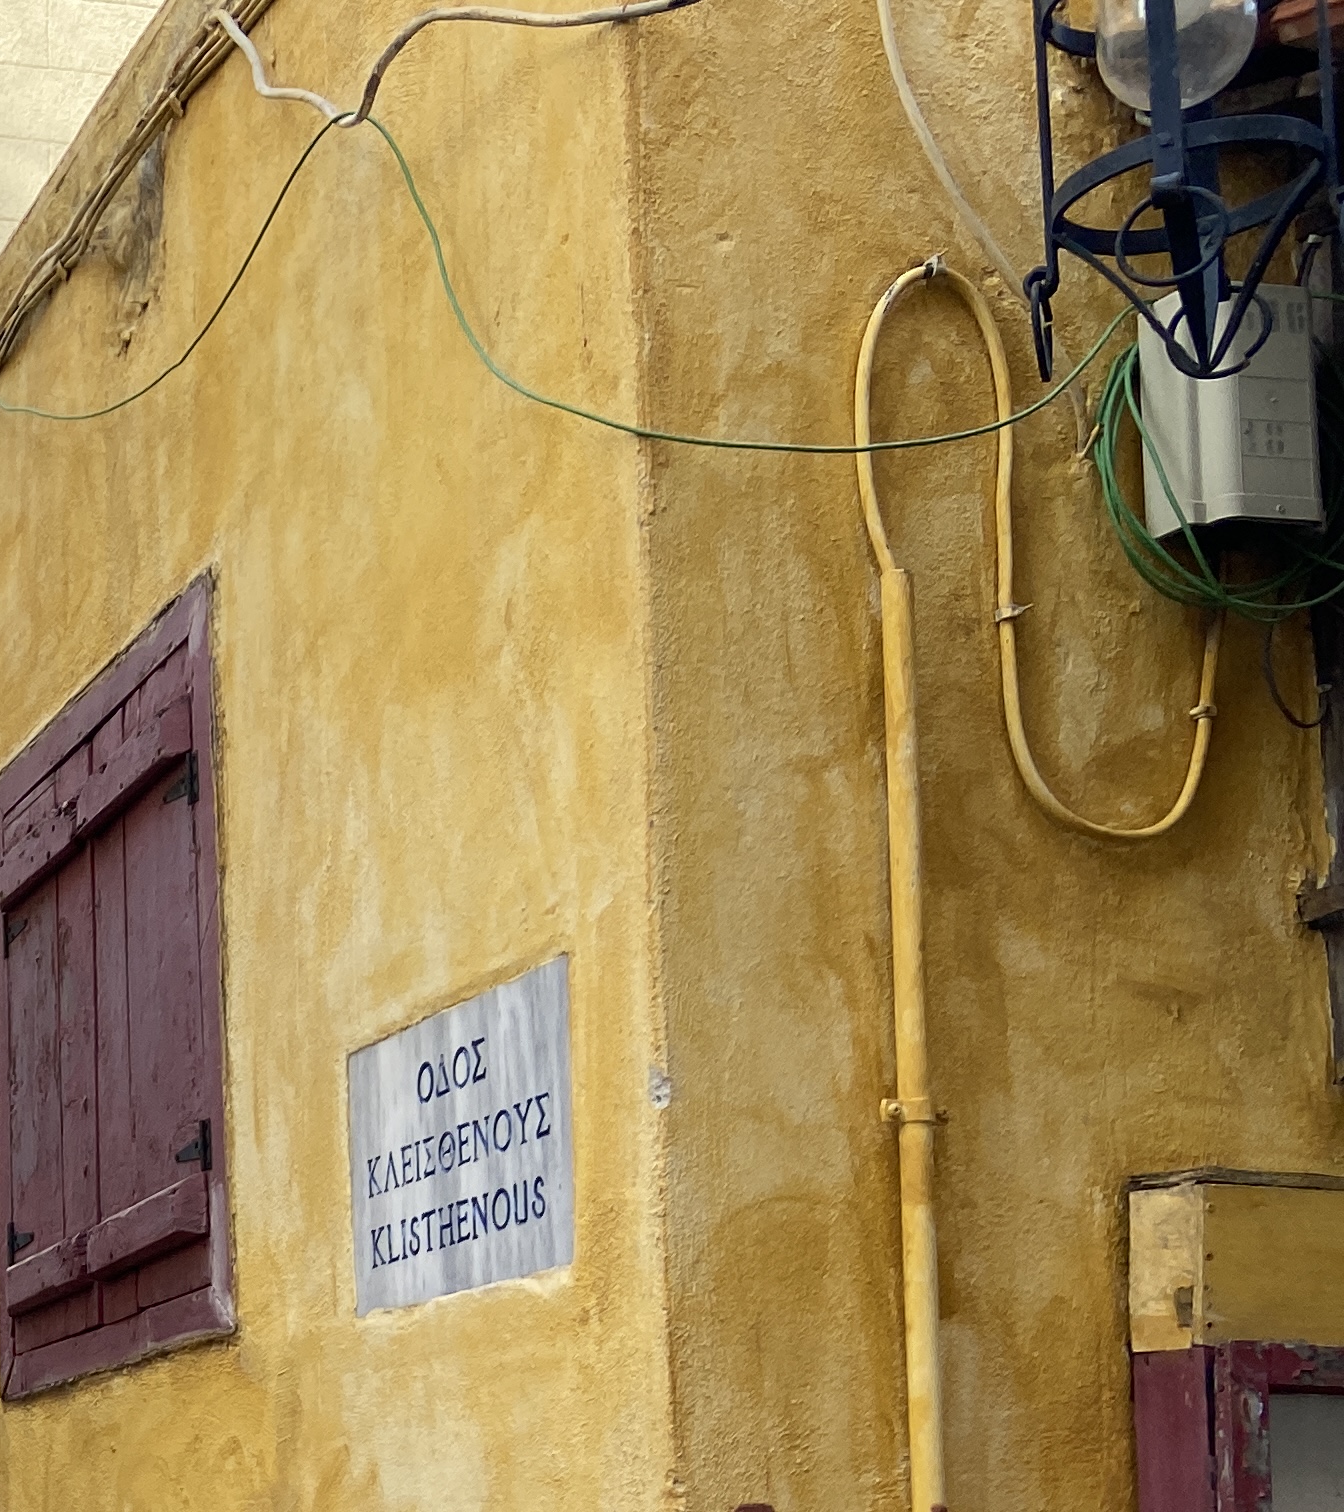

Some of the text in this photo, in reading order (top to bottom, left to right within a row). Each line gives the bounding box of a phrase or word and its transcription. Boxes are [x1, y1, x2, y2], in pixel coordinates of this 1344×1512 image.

[417, 1037, 486, 1104] ΟΔΟΣ
[367, 1092, 551, 1198] ΚΛΕΙΣΘΕΝΟΥΣ
[371, 1176, 547, 1269] KLISTHENOUS
